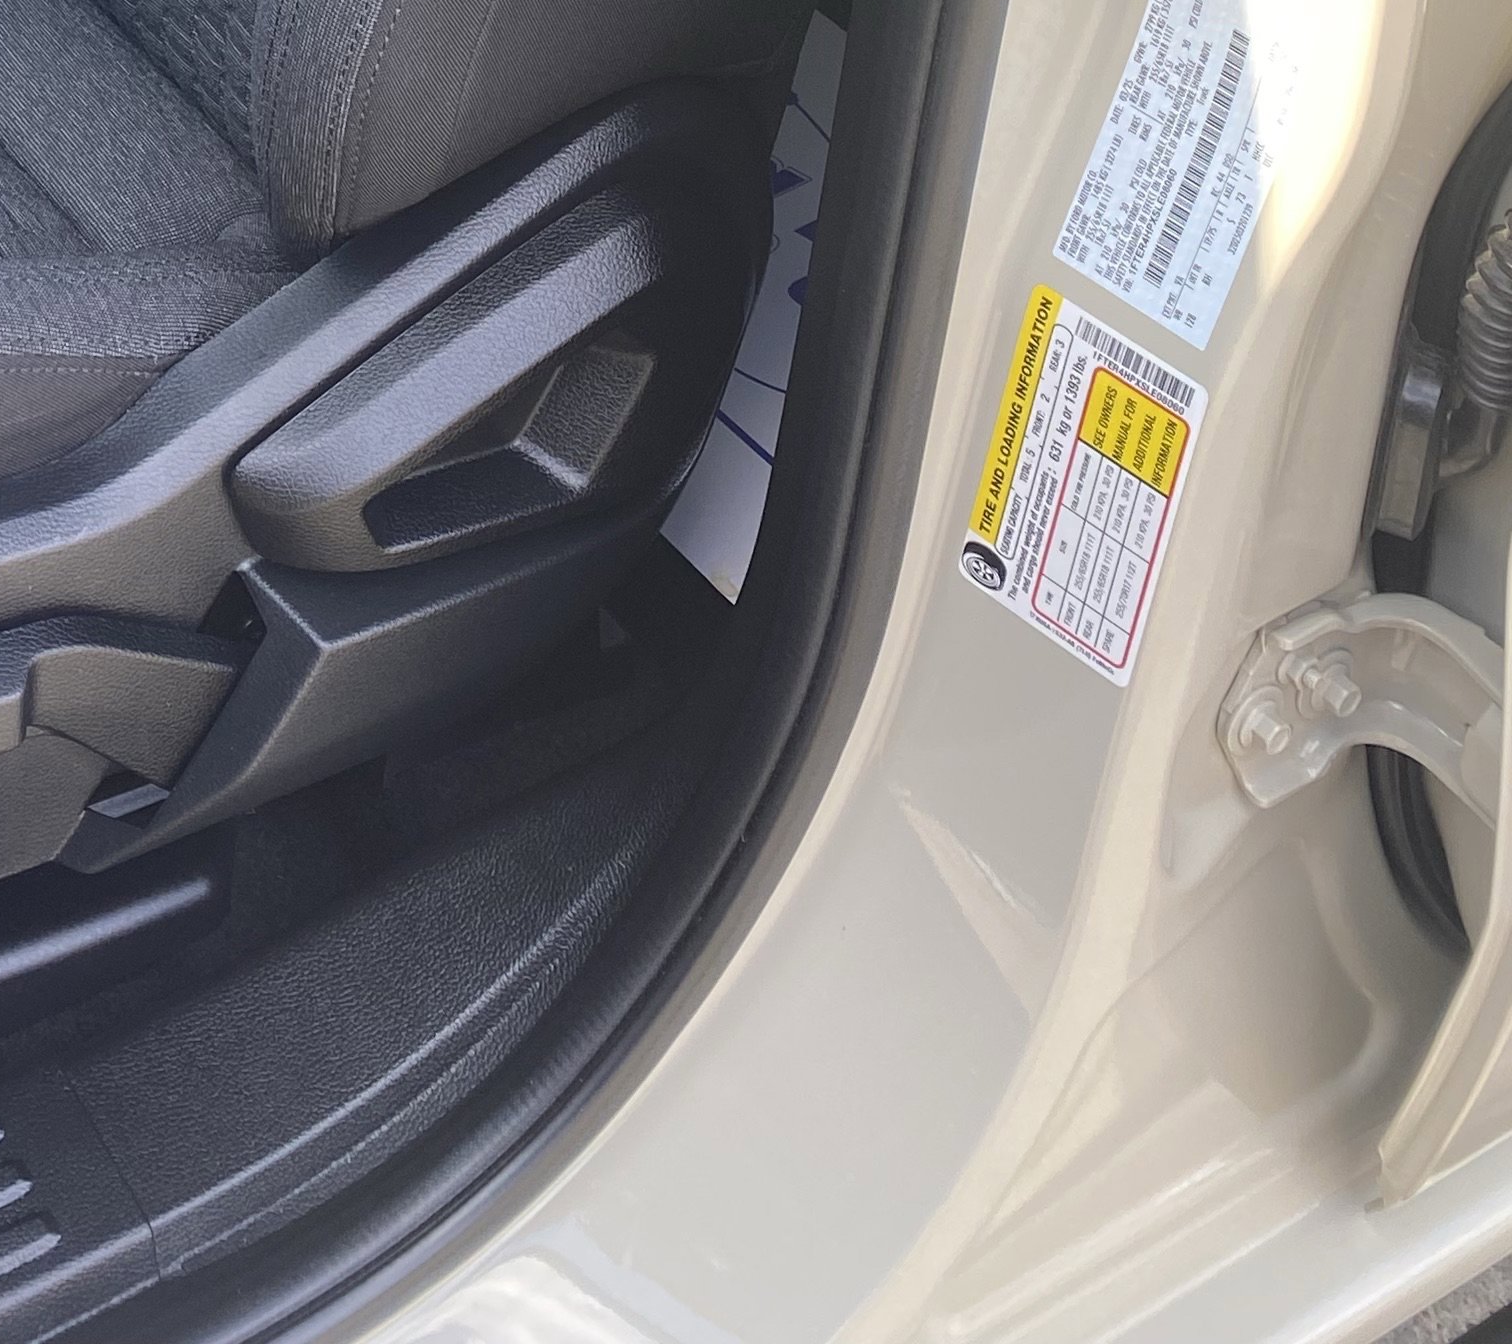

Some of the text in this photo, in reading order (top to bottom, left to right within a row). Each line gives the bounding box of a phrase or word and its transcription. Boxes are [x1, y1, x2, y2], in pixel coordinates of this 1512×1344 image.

[1190, 62, 1204, 90] SHOWN
[1129, 85, 1141, 103] REAR
[1138, 90, 1151, 108] WITH
[1164, 83, 1176, 99] 210
[1196, 85, 1208, 105] Truck
[1172, 89, 1197, 139] MANUFACTURE
[1069, 204, 1082, 224] FORD
[1077, 179, 1092, 205] MOTOR
[1109, 103, 1123, 124] DATE:
[1118, 78, 1133, 102] 03/25
[1168, 138, 1178, 149] OF
[1133, 157, 1147, 178] COLD
[1160, 148, 1174, 167] DATE
[1103, 58, 1196, 281] THIS VEHICLE CONFORMS TO ALL APPLICABLE FEDERAL MOTOR VEHICLE
[1155, 166, 1167, 180] THE
[1128, 176, 1140, 189] PSI
[1150, 179, 1161, 192] ON
[1141, 190, 1156, 215] EFFECT
[1067, 234, 1081, 258] FRONT
[1090, 179, 1104, 199] 1485
[1100, 244, 1111, 260] 210
[1122, 222, 1143, 263] STANDARDS
[1076, 243, 1089, 264] WITH
[1094, 264, 1104, 275] AT
[1112, 261, 1128, 287] SAFETY
[978, 294, 1052, 535] TIRE AND LOADING INFORMATION
[1092, 384, 1118, 449] SEE OWNERS
[1111, 396, 1137, 462] MANUAL FOR
[1000, 524, 1014, 555] SEATING
[1007, 492, 1023, 527] CAPACITY
[1025, 447, 1035, 457] 5
[1040, 392, 1050, 403] 2
[1054, 338, 1065, 349] 3
[1131, 411, 1156, 472] ADDITIONAL
[1150, 417, 1178, 488] INFORMATION
[1020, 350, 1087, 594] and cargo should never exceed 631 kg or 1393 lbs.
[1104, 463, 1114, 478] PSI
[1101, 475, 1111, 489] 30
[1123, 476, 1134, 491] PSI
[1120, 487, 1131, 502] 30
[1145, 491, 1156, 506] PSI
[1092, 503, 1103, 521] 210
[1142, 502, 1153, 517] 30
[1007, 469, 1050, 601] The combined weight of occupants
[1111, 516, 1123, 534] 210
[1083, 532, 1095, 552] 111T
[1103, 545, 1114, 565] 111T
[1073, 550, 1091, 591] 255/65R18
[1092, 563, 1110, 604] 255/65R18
[1063, 601, 1076, 627] FRONT
[1082, 618, 1094, 640] REAR
[1101, 628, 1114, 653] SPARE
